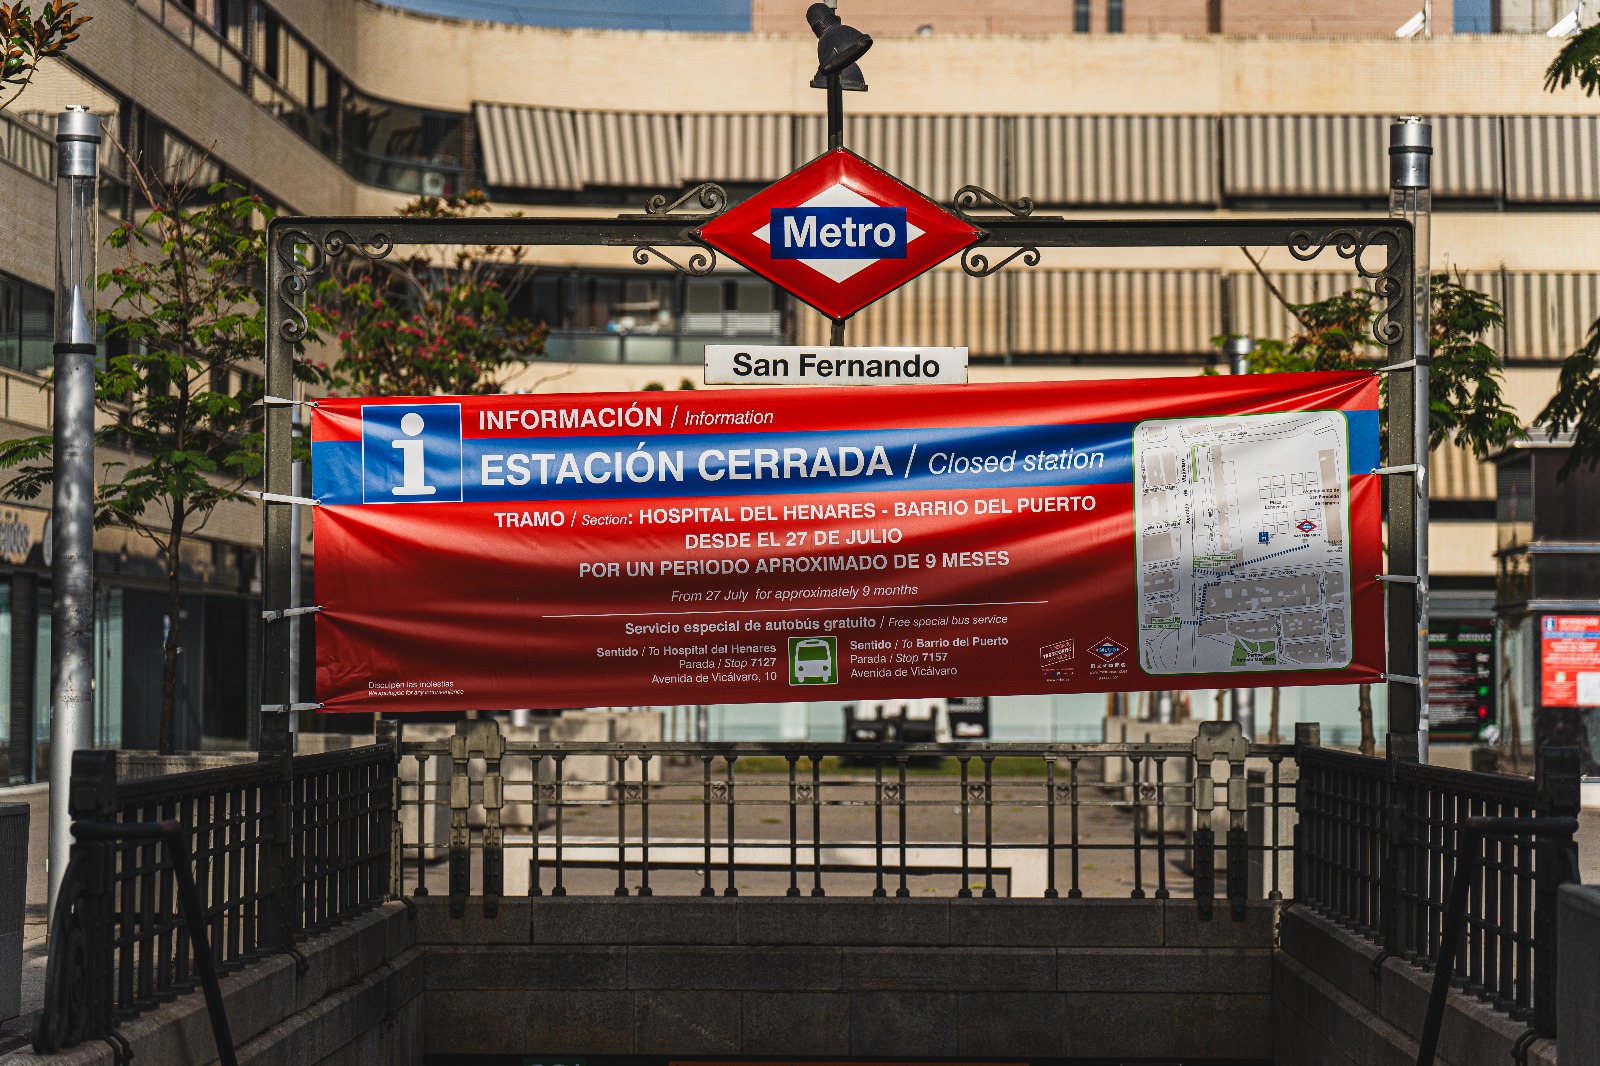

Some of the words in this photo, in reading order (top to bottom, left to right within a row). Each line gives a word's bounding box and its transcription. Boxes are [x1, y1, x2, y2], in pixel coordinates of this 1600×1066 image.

[783, 215, 896, 248] Metro
[732, 352, 788, 377] San
[799, 353, 940, 378] Fernando
[479, 401, 662, 430] INFORMACIÓN
[684, 410, 774, 426] Information
[481, 441, 684, 486] ESTACIÓN
[697, 445, 894, 483] CERRADA
[928, 450, 1017, 475] Closed
[1023, 448, 1105, 473] station
[494, 510, 565, 528] TRAMO
[639, 507, 736, 525] HOSPITAL
[740, 505, 778, 522] DEL
[783, 502, 876, 521] HENARES
[894, 499, 969, 517] BARRIO
[974, 498, 1013, 515] DEL
[1017, 495, 1097, 513] PUERTO
[685, 532, 751, 550] DESDE
[757, 532, 781, 547] EL
[785, 531, 808, 547] 27
[814, 530, 840, 546] DE
[845, 527, 903, 546] JULIO
[579, 562, 620, 578] POR
[626, 561, 654, 577] UN
[660, 558, 750, 576] PERIODO
[755, 554, 888, 574] APROXIMADO
[893, 553, 920, 569] DE
[925, 553, 936, 569] 9
[942, 550, 1010, 568] MESES
[671, 590, 703, 602] From
[705, 590, 722, 601] 27
[723, 589, 749, 603] July
[754, 588, 772, 600] for
[774, 586, 859, 601] approximately
[862, 585, 871, 597] 9
[873, 584, 918, 596] months
[625, 621, 680, 635] Servicio
[683, 620, 740, 636] especial
[744, 619, 762, 631] de
[765, 617, 820, 631] autobús
[823, 616, 876, 632] gratuito
[888, 617, 911, 627] Free
[912, 615, 949, 628] special
[951, 615, 970, 625] bus
[972, 614, 1008, 625] service
[596, 646, 639, 657] Sentido
[648, 646, 660, 656] To
[663, 644, 708, 658] Hospital
[711, 643, 728, 654] del
[731, 642, 777, 653] Henares
[850, 639, 892, 650] Sentido
[902, 639, 913, 649] To
[916, 637, 950, 648] Barrio
[952, 637, 969, 647] del
[972, 636, 1009, 647] Puerto
[679, 659, 715, 669] Parada
[724, 658, 748, 670] Stop
[750, 657, 777, 667] 7127
[850, 653, 887, 664] Parada
[896, 652, 919, 664] Stop
[922, 652, 948, 662] 7157
[651, 673, 693, 684] Avenida
[695, 673, 709, 682] de
[711, 671, 761, 683] Vicálvaro,
[764, 671, 777, 681] 10
[850, 667, 892, 678] Avenida
[894, 667, 907, 677] de
[910, 665, 958, 676] Vicálvaro
[368, 681, 405, 690] Disculpen
[419, 680, 454, 688] molestias
